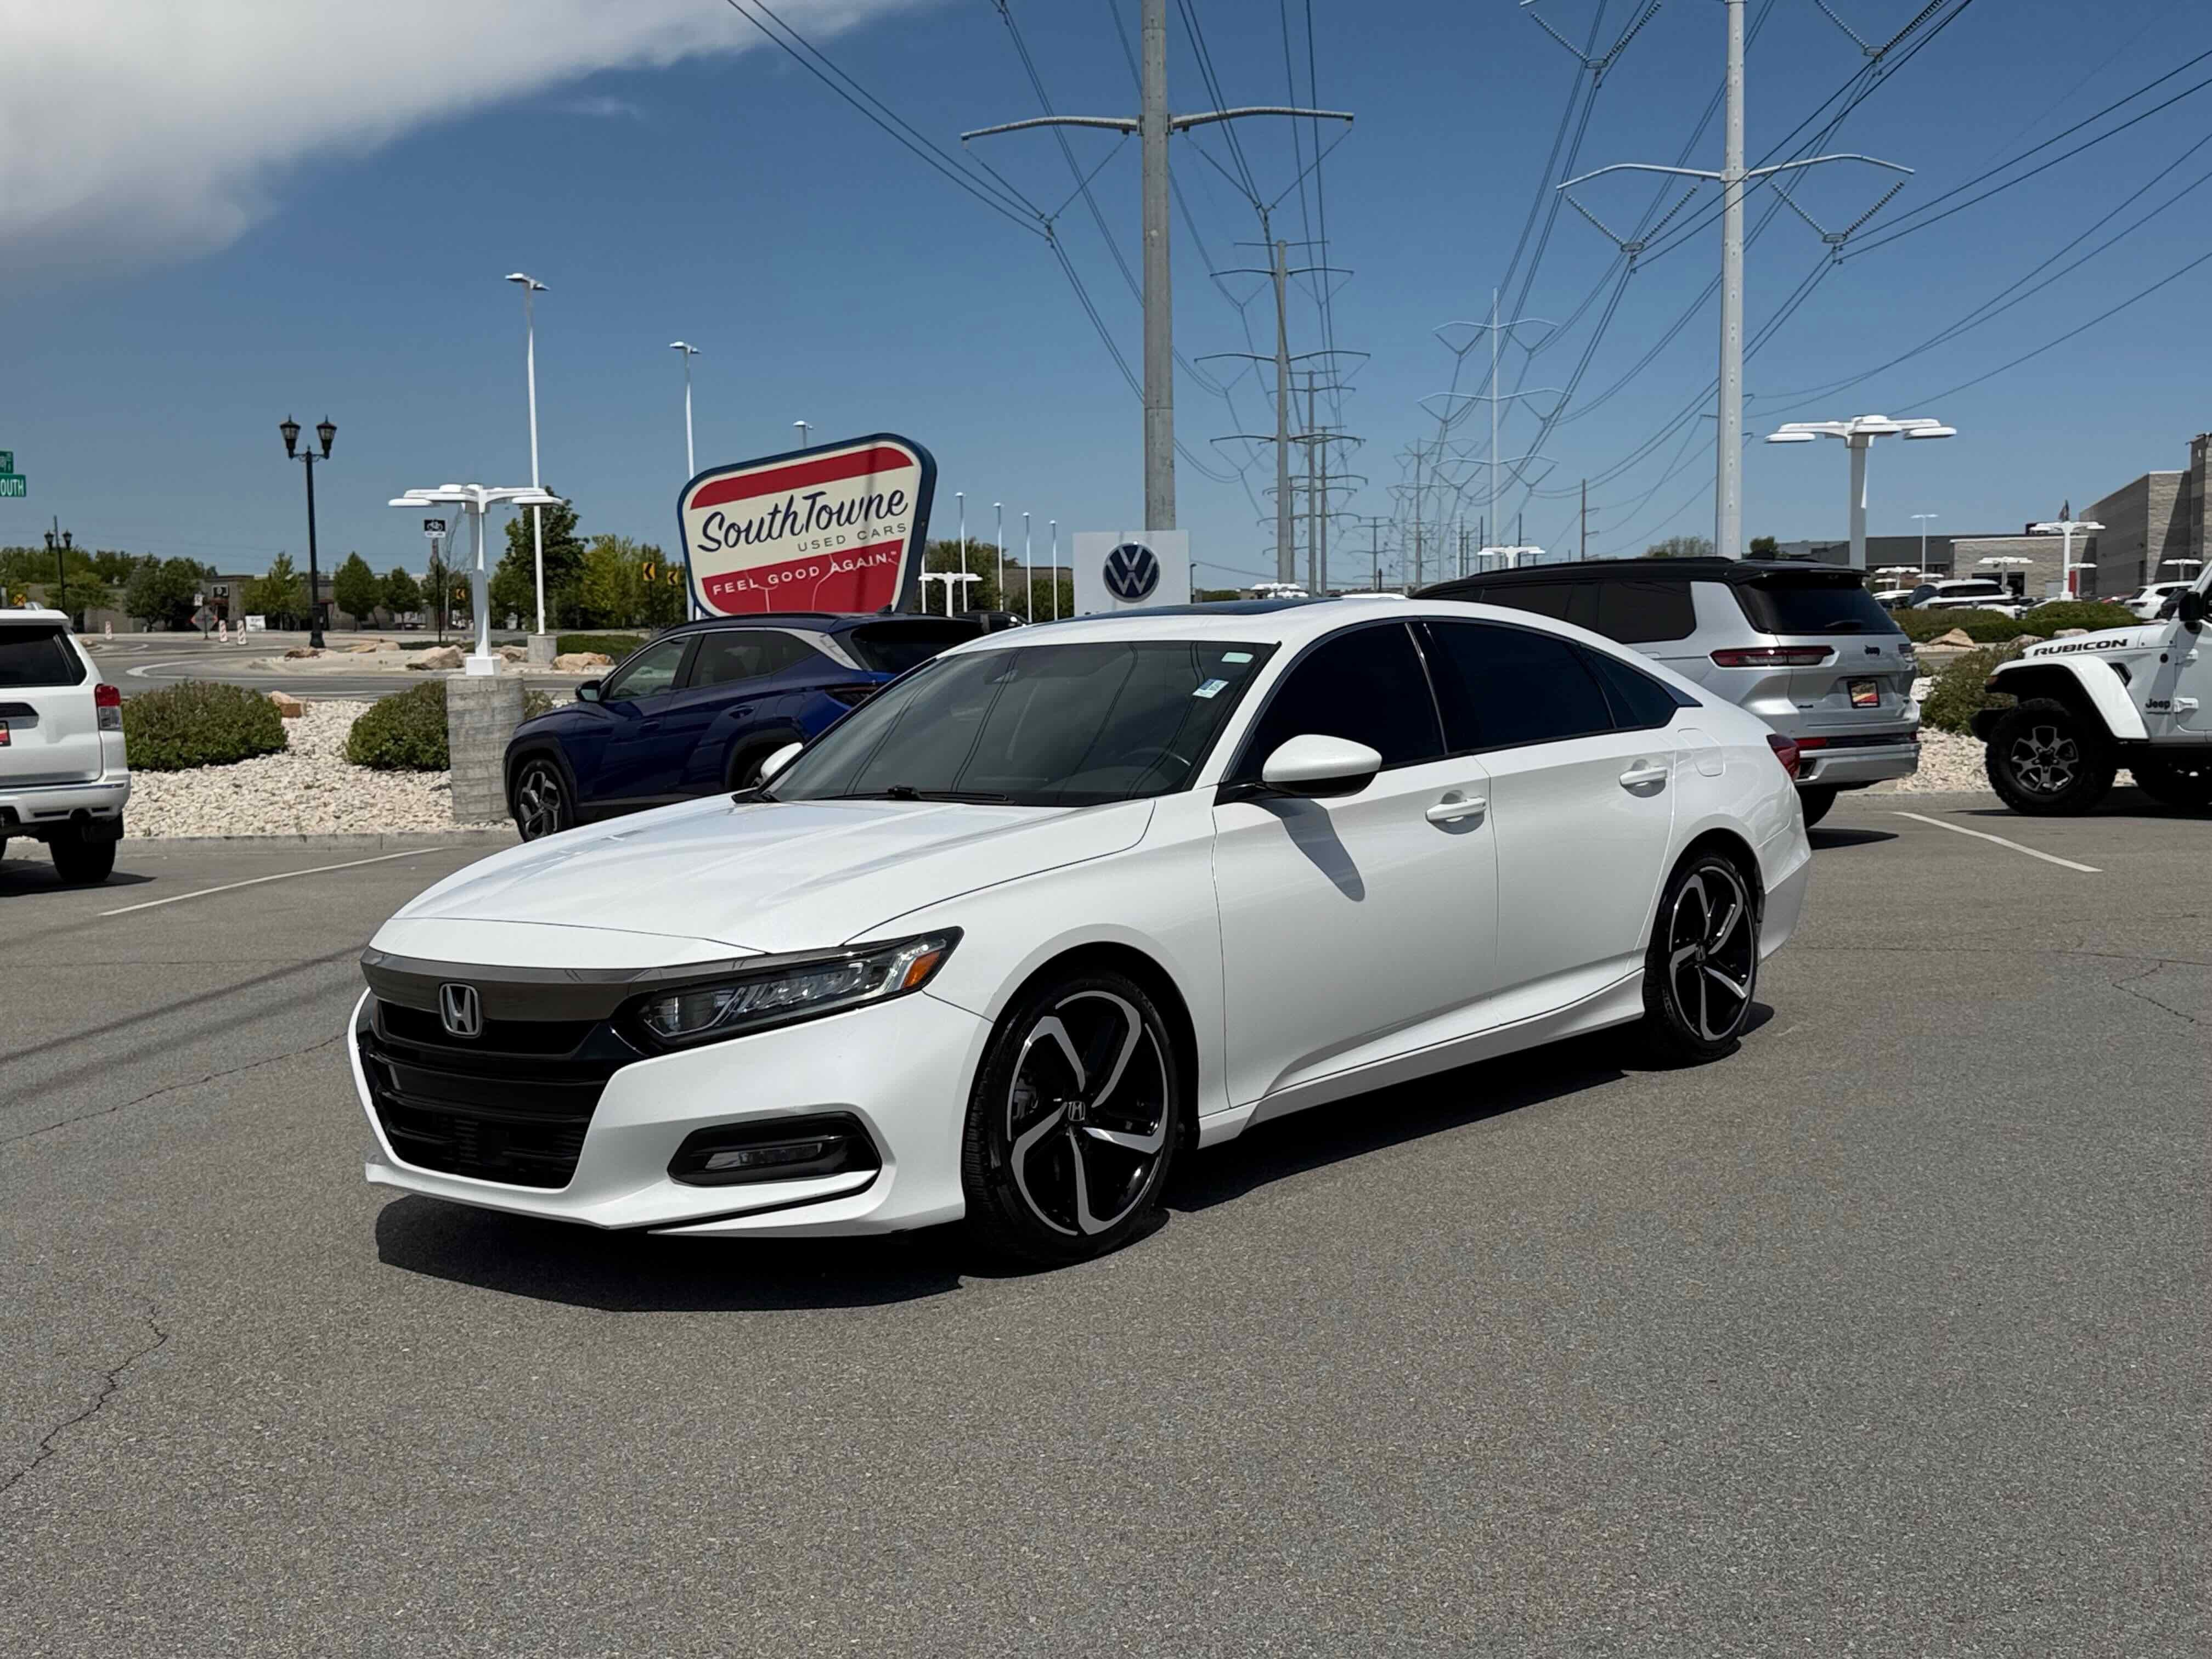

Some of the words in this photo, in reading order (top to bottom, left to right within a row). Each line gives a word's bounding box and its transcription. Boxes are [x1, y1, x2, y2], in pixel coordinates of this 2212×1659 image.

[0, 478, 24, 496] OUTH
[798, 535, 847, 552] USED
[857, 523, 907, 540] CARS
[713, 579, 759, 596] FEEL
[768, 566, 820, 585] GOOD
[2033, 639, 2129, 657] RUBICON
[2145, 698, 2171, 710] Jeep
